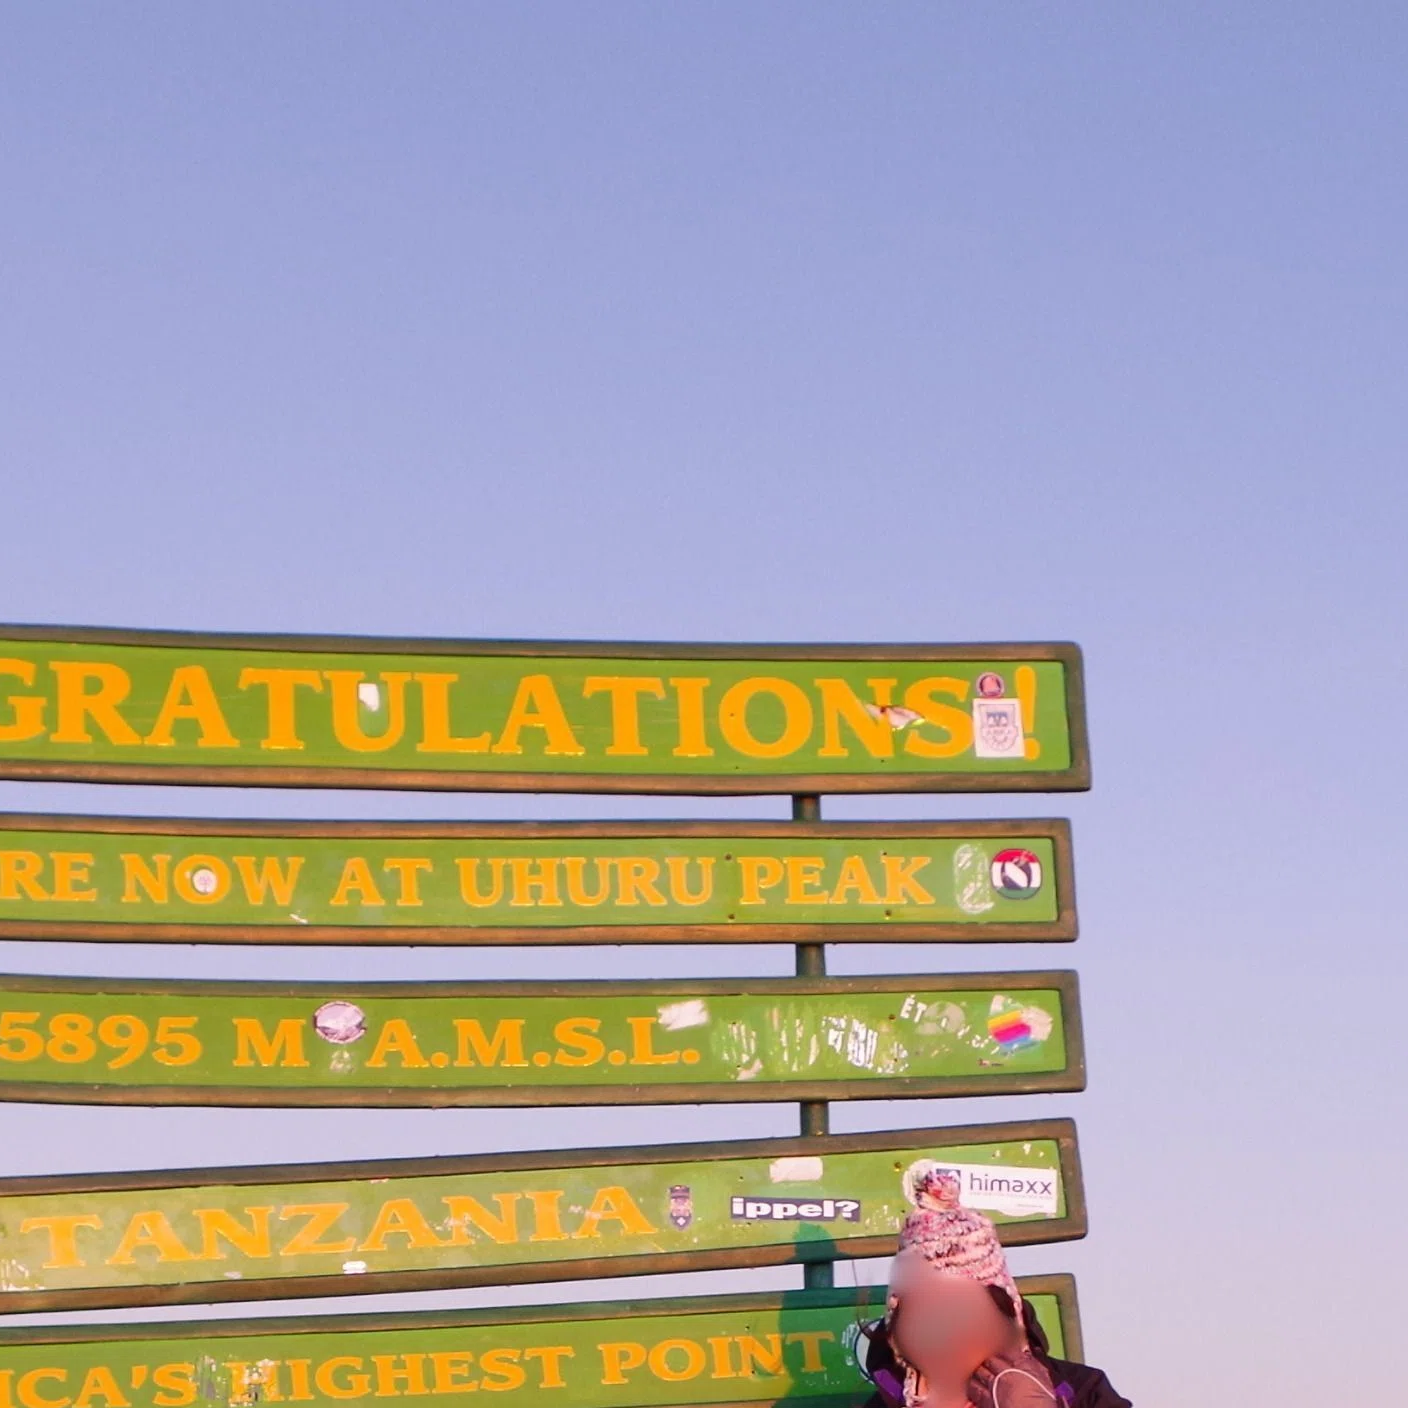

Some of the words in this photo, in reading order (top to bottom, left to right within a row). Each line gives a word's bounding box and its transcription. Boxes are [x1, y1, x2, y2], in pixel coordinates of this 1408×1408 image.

[121, 852, 304, 907] NOW
[330, 856, 432, 907] AT
[455, 856, 715, 907] UHURU
[738, 854, 935, 906] PEAK
[365, 1016, 701, 1069] A.M.S.L.
[970, 1172, 1052, 1195] himaxx
[20, 1186, 656, 1269] TANZANIA
[225, 1345, 575, 1405] HIGHEST
[598, 1330, 836, 1385] POINT
